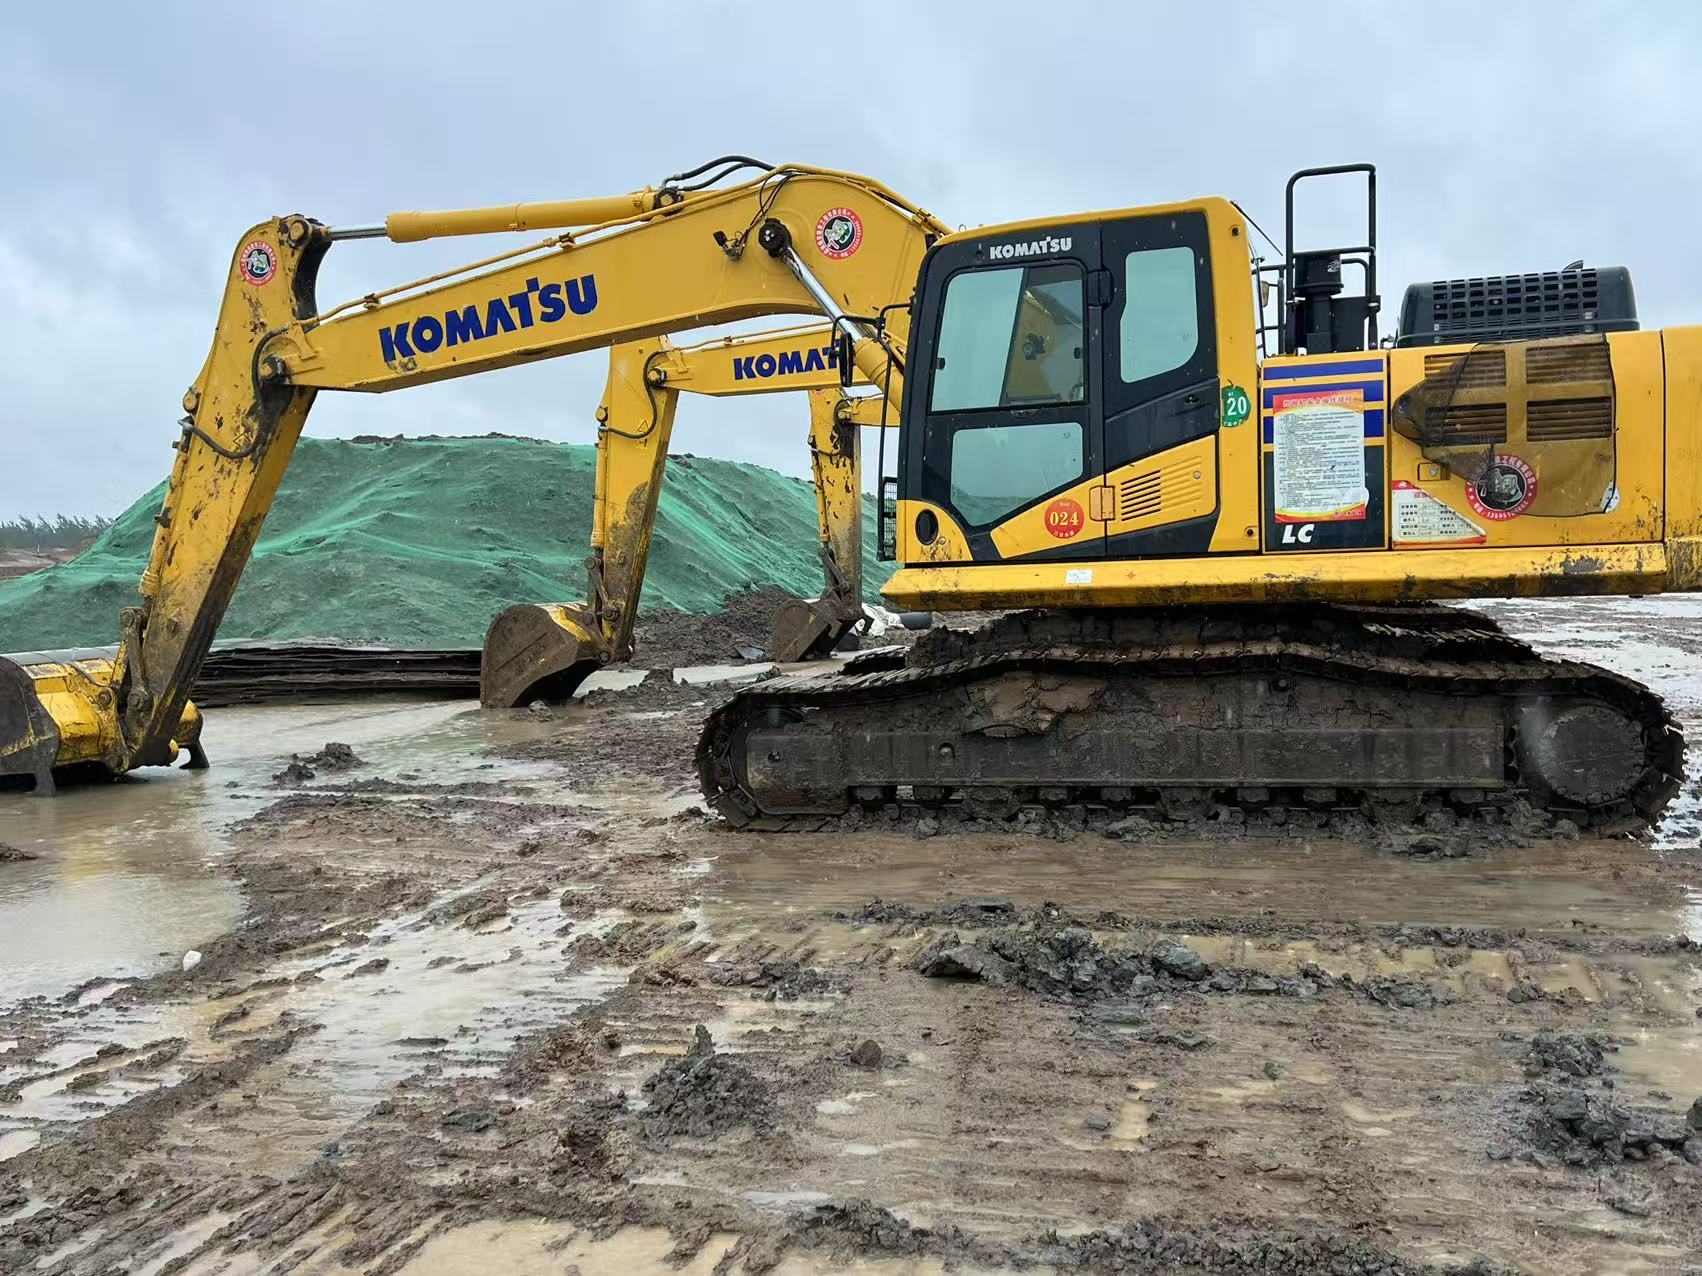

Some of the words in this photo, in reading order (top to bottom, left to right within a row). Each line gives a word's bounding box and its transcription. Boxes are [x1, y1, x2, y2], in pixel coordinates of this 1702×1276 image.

[990, 236, 1072, 260] KOMATSU
[378, 274, 598, 363] KOMATSU
[733, 339, 841, 381] KOMAT
[1227, 396, 1247, 416] 20
[1049, 511, 1079, 526] 024
[1282, 523, 1315, 544] LC
